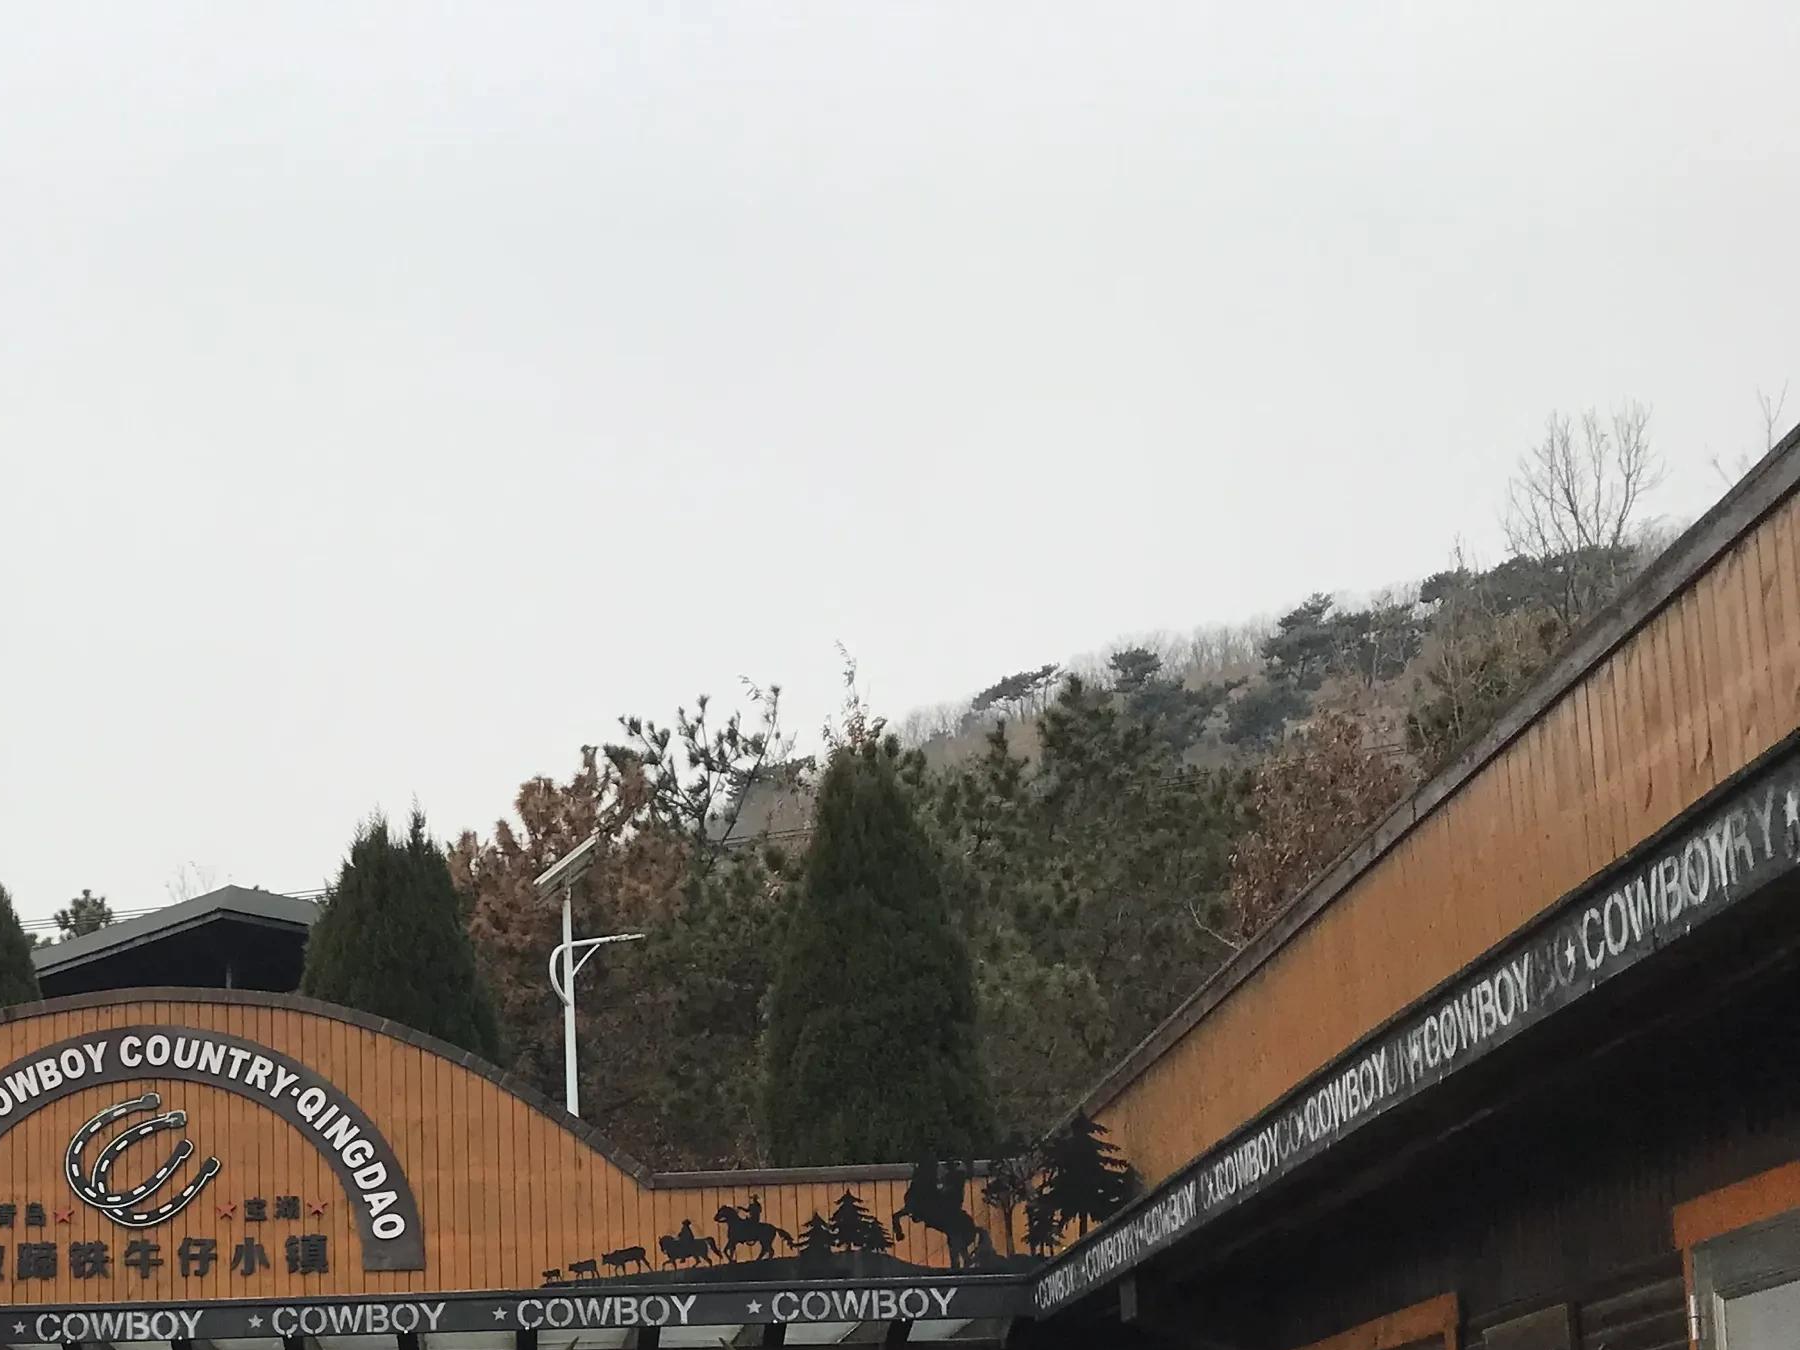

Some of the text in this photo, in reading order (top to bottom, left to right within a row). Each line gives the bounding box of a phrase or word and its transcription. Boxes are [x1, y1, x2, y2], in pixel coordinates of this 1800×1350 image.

[1583, 815, 1732, 970] COWBOY
[1422, 953, 1529, 1067] COWBOY
[1305, 1046, 1386, 1142] COWBOY
[1214, 1122, 1279, 1201] COWBOY
[770, 1287, 959, 1322] COWBOY
[1038, 1262, 1075, 1310] COWBOY
[35, 1309, 204, 1342] COWBOY
[271, 1301, 447, 1336] COWBOY
[516, 1294, 697, 1329] COWBOY
